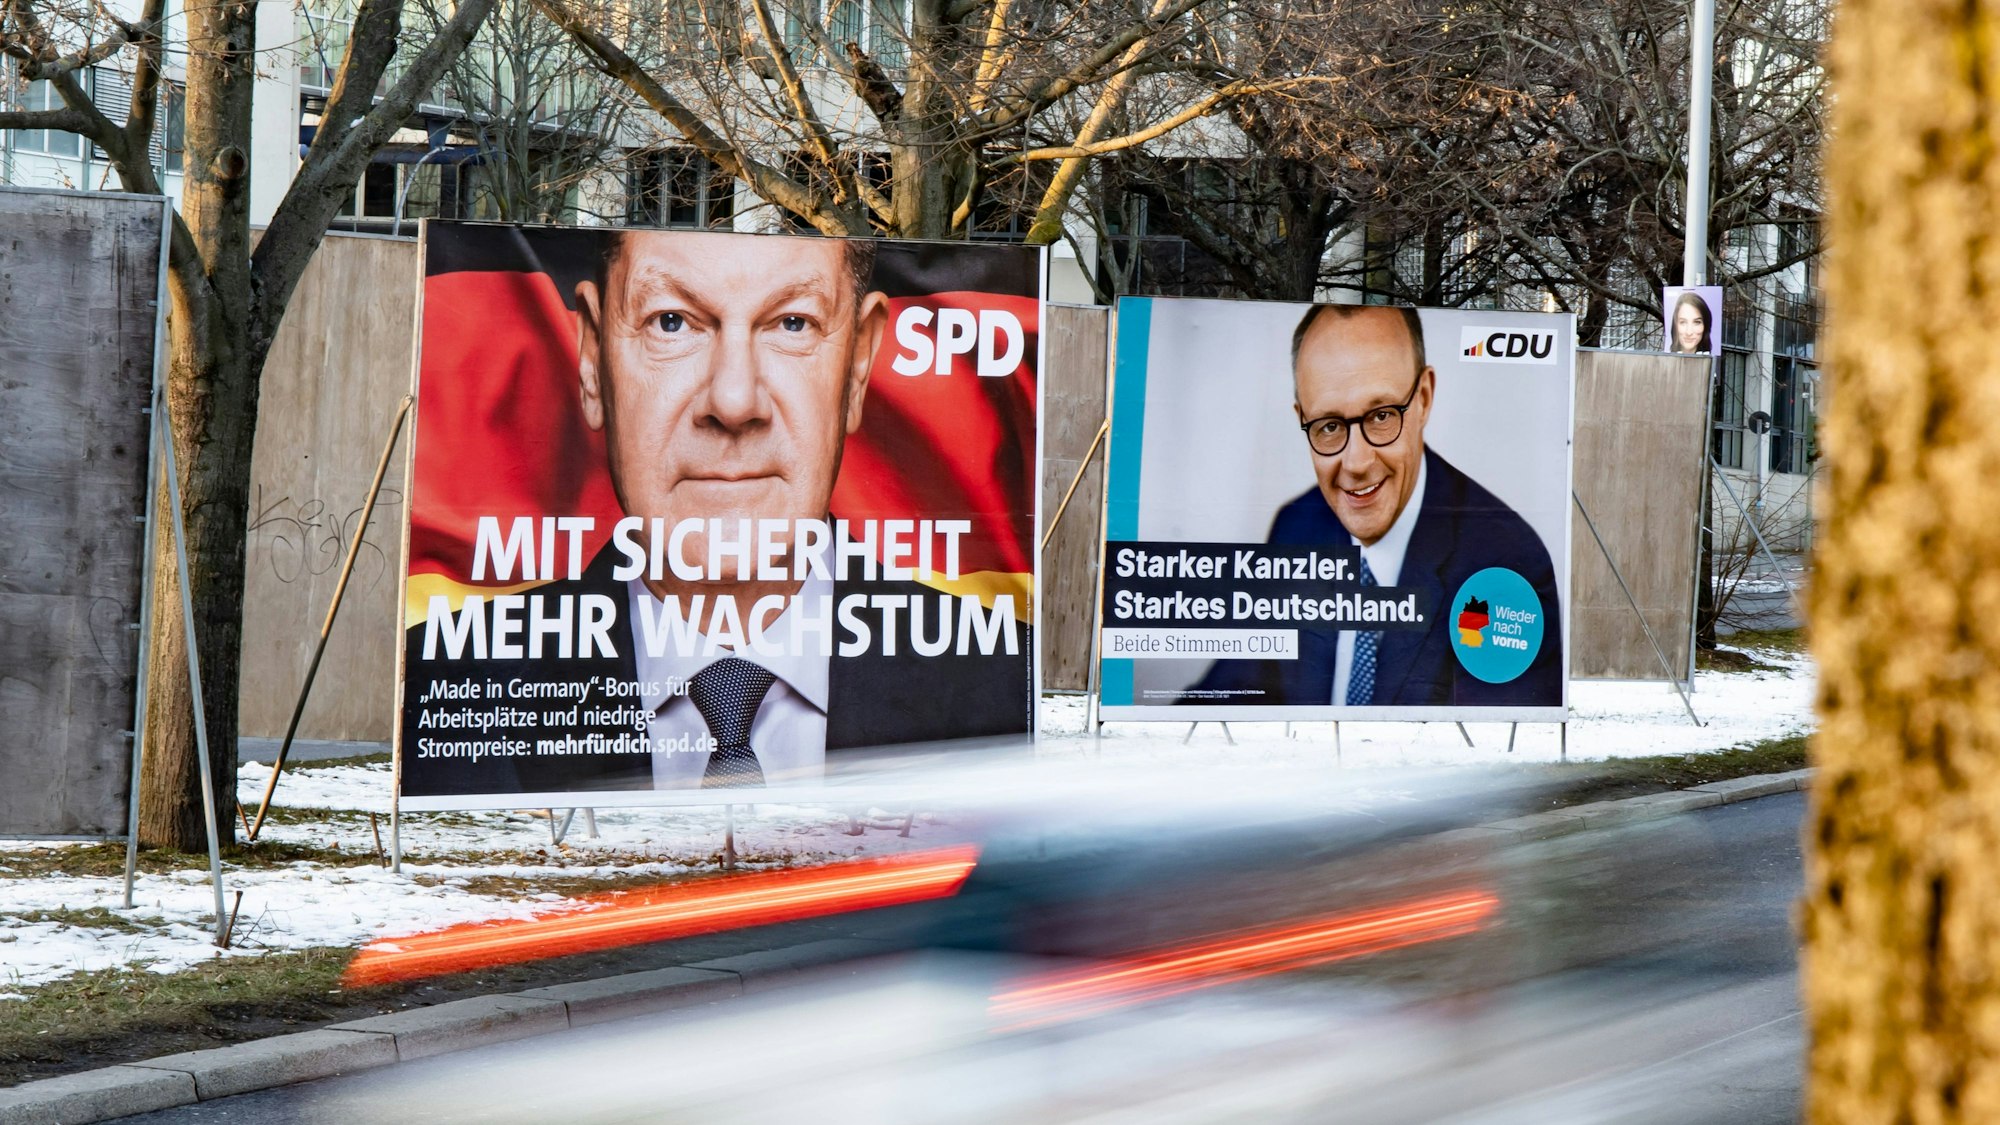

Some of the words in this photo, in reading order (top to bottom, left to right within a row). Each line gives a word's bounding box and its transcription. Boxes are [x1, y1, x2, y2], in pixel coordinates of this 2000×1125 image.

[891, 305, 1025, 377] SPD
[1485, 332, 1553, 359] CDU
[471, 515, 595, 582] MIT
[612, 514, 972, 583] SICHERHEIT
[1115, 548, 1227, 579] Starker
[1233, 550, 1355, 581] Kanzler.
[1113, 589, 1226, 620] Starkes
[1232, 591, 1424, 622] Deutschland.
[1495, 605, 1537, 624] Wieder
[421, 594, 618, 662] MEHR
[637, 593, 1020, 659] WACHSTUM
[1493, 621, 1522, 635] nach
[1113, 635, 1160, 652] Beide
[1165, 635, 1242, 653] Stimmen
[1247, 635, 1289, 653] CDU.
[1492, 634, 1528, 650] vorne
[486, 678, 502, 698] in
[665, 676, 693, 697] für
[418, 707, 538, 733] Arbeitsplätze
[543, 706, 578, 727] und
[583, 705, 656, 731] niedrige
[418, 735, 531, 763] Strompreise:
[537, 732, 718, 760] mehrfürdich.spd.de
